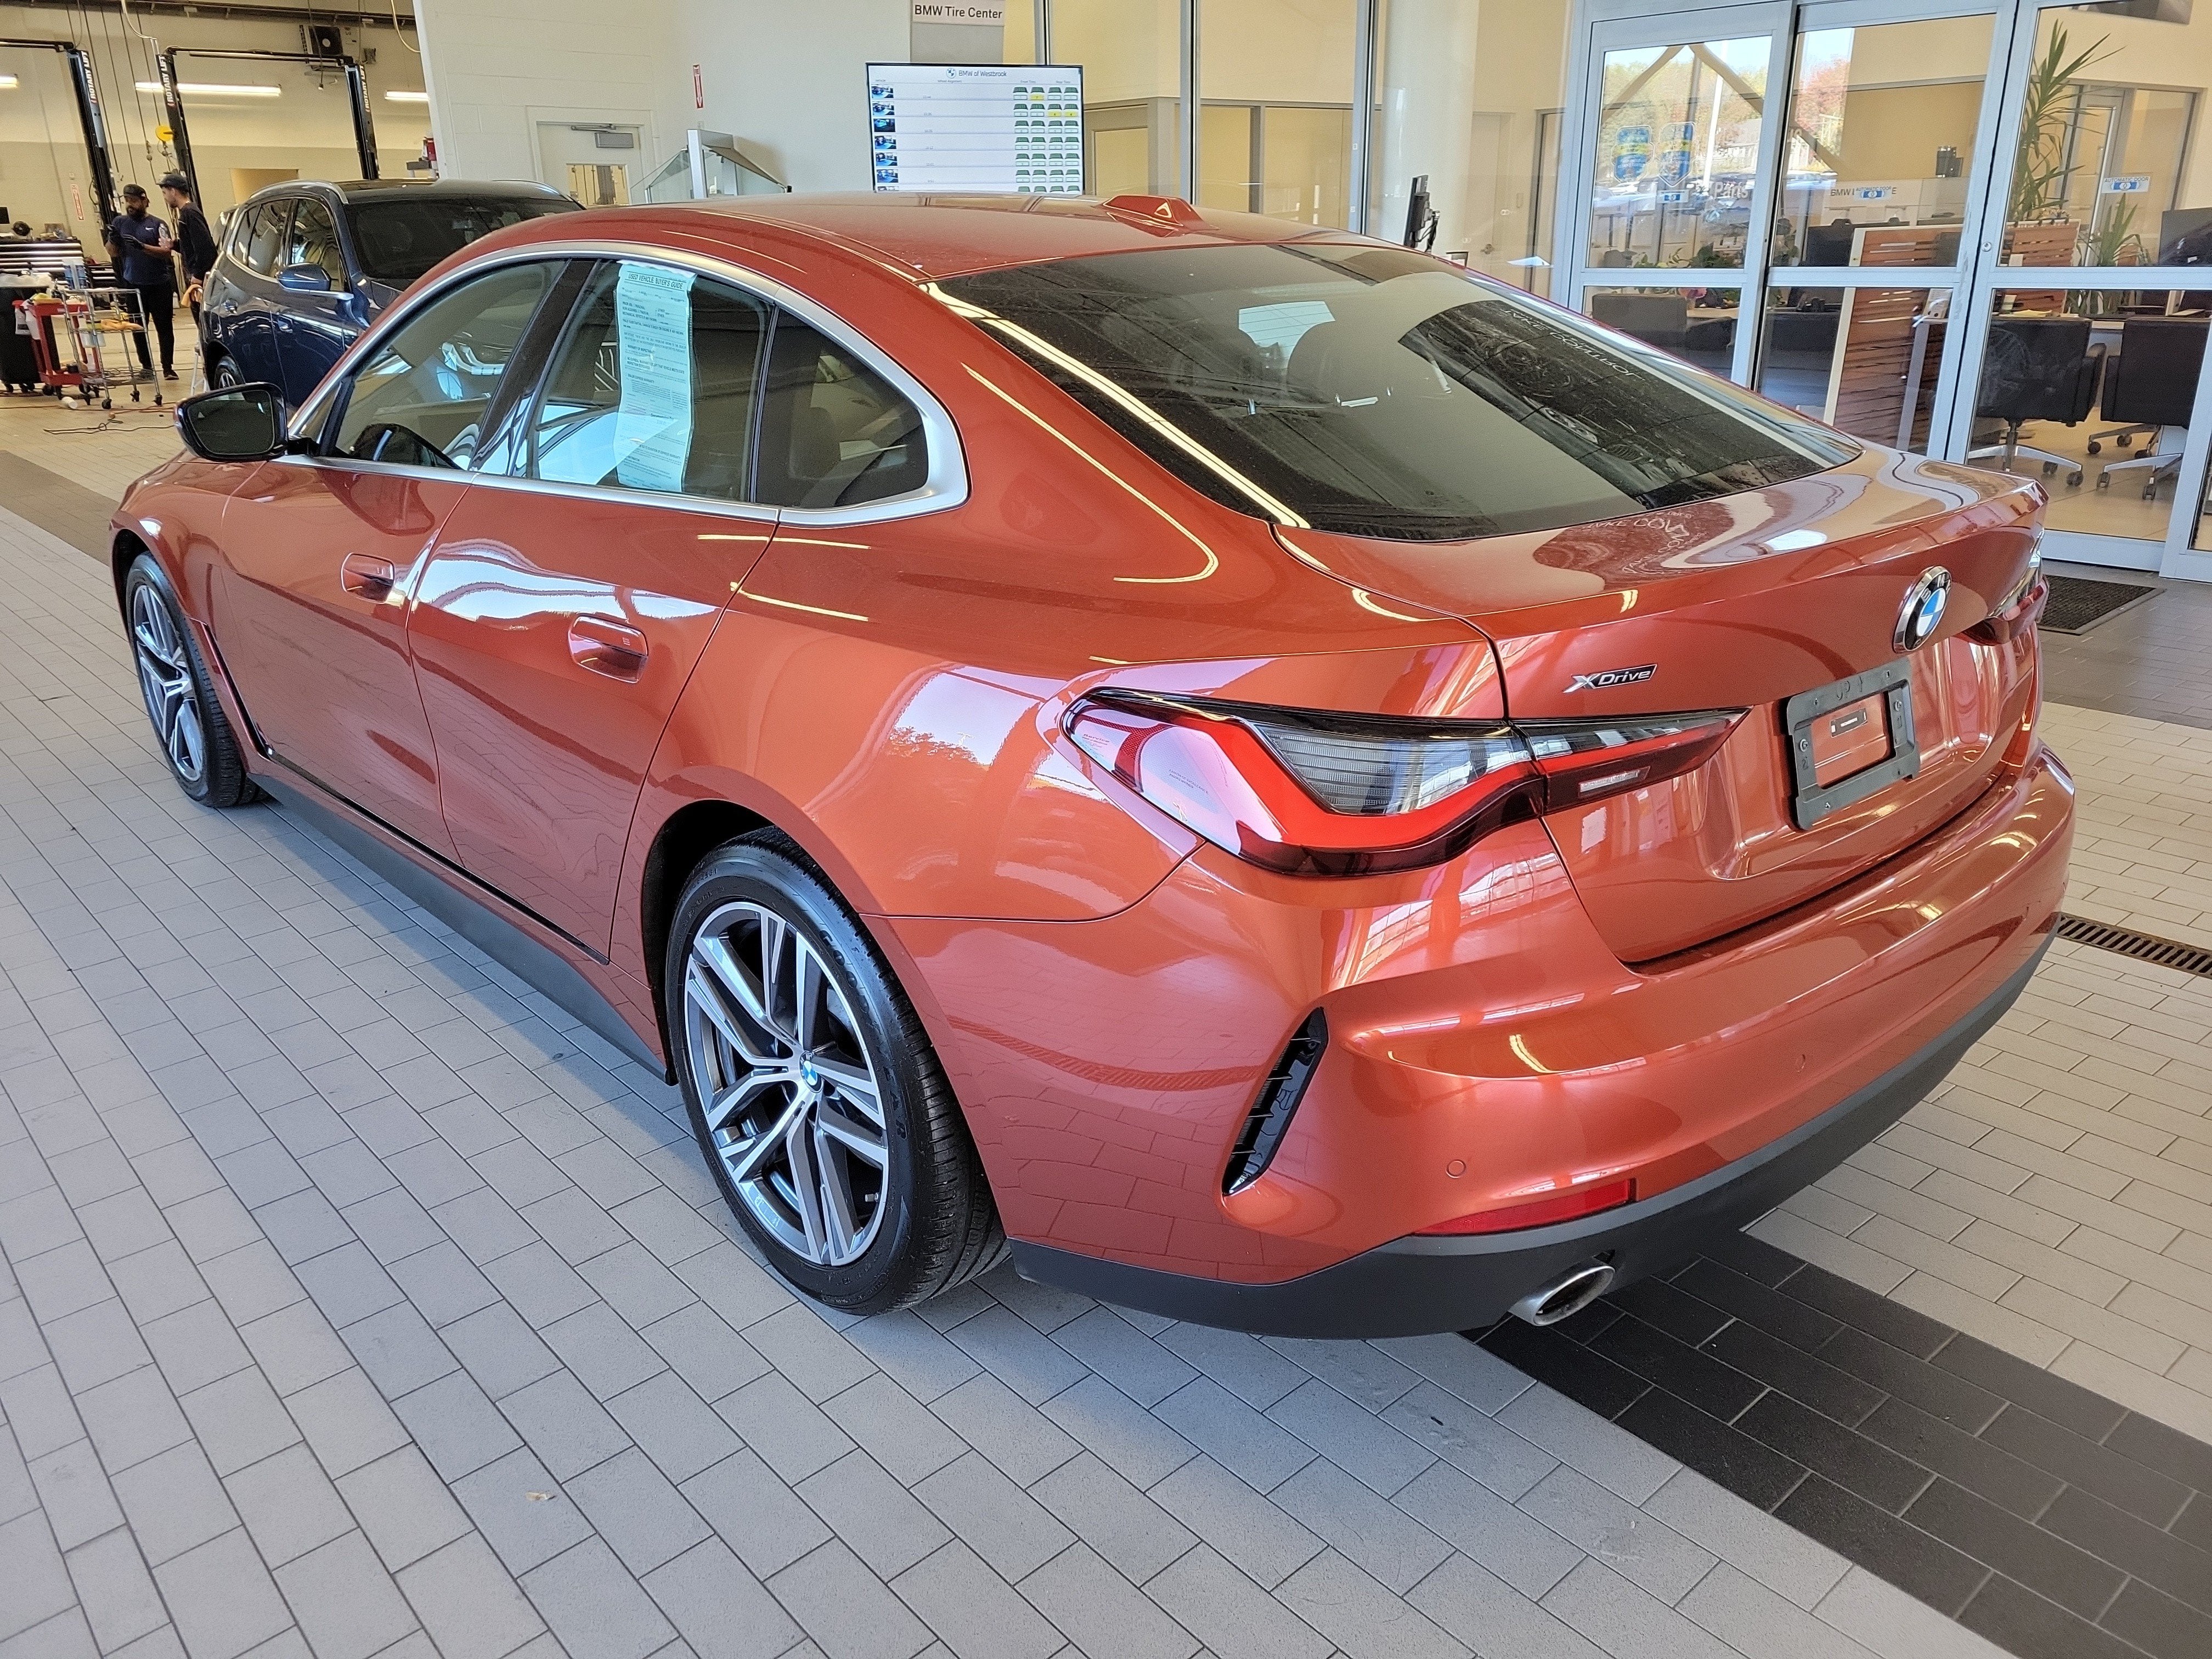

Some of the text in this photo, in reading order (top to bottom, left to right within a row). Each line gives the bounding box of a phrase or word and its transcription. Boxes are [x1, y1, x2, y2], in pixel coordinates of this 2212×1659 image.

[915, 4, 1002, 19] BMW Tire Center
[81, 51, 97, 99] ROTARY LIFT
[158, 55, 174, 103] ROTARY LIFT
[639, 275, 654, 284] VEHICLE
[655, 278, 670, 286] BUYER'S
[670, 280, 683, 289] GUIDE
